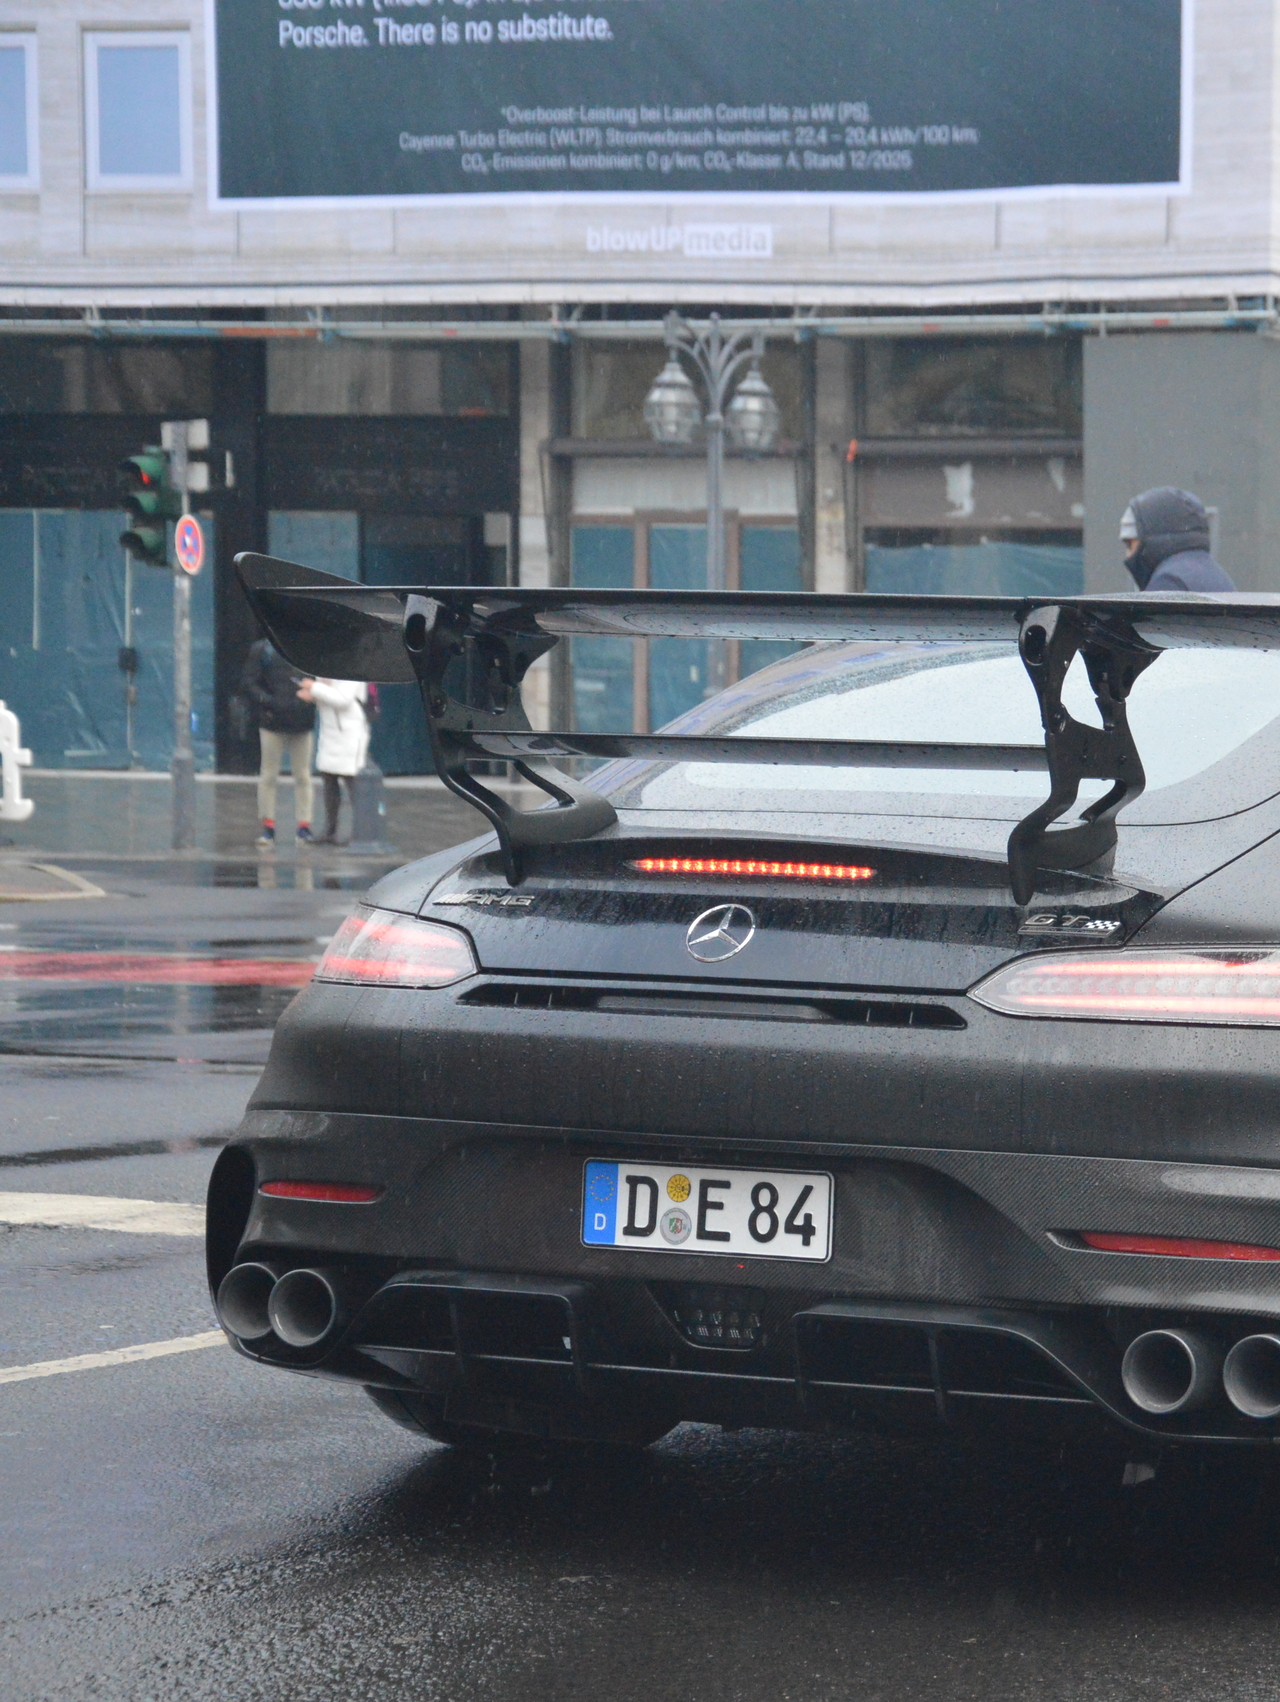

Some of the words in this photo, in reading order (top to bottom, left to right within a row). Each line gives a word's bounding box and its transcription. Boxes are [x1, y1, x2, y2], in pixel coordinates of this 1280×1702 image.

[278, 19, 369, 48] Porsche.
[374, 17, 435, 46] There
[442, 15, 459, 44] is
[465, 20, 494, 44] no
[498, 11, 614, 42] substitute.
[641, 104, 660, 122] bei
[664, 103, 713, 123] Launch
[716, 102, 766, 123] Control
[768, 102, 789, 122] bis
[399, 132, 455, 154] Cayenne
[458, 129, 496, 148] Turbo
[498, 128, 547, 147] Electric
[803, 150, 845, 170] Stand
[686, 224, 768, 251] media
[1025, 914, 1091, 926] GT
[594, 1213, 606, 1230] D
[622, 1174, 659, 1237] D
[696, 1179, 731, 1242] E
[747, 1181, 816, 1247] 84
